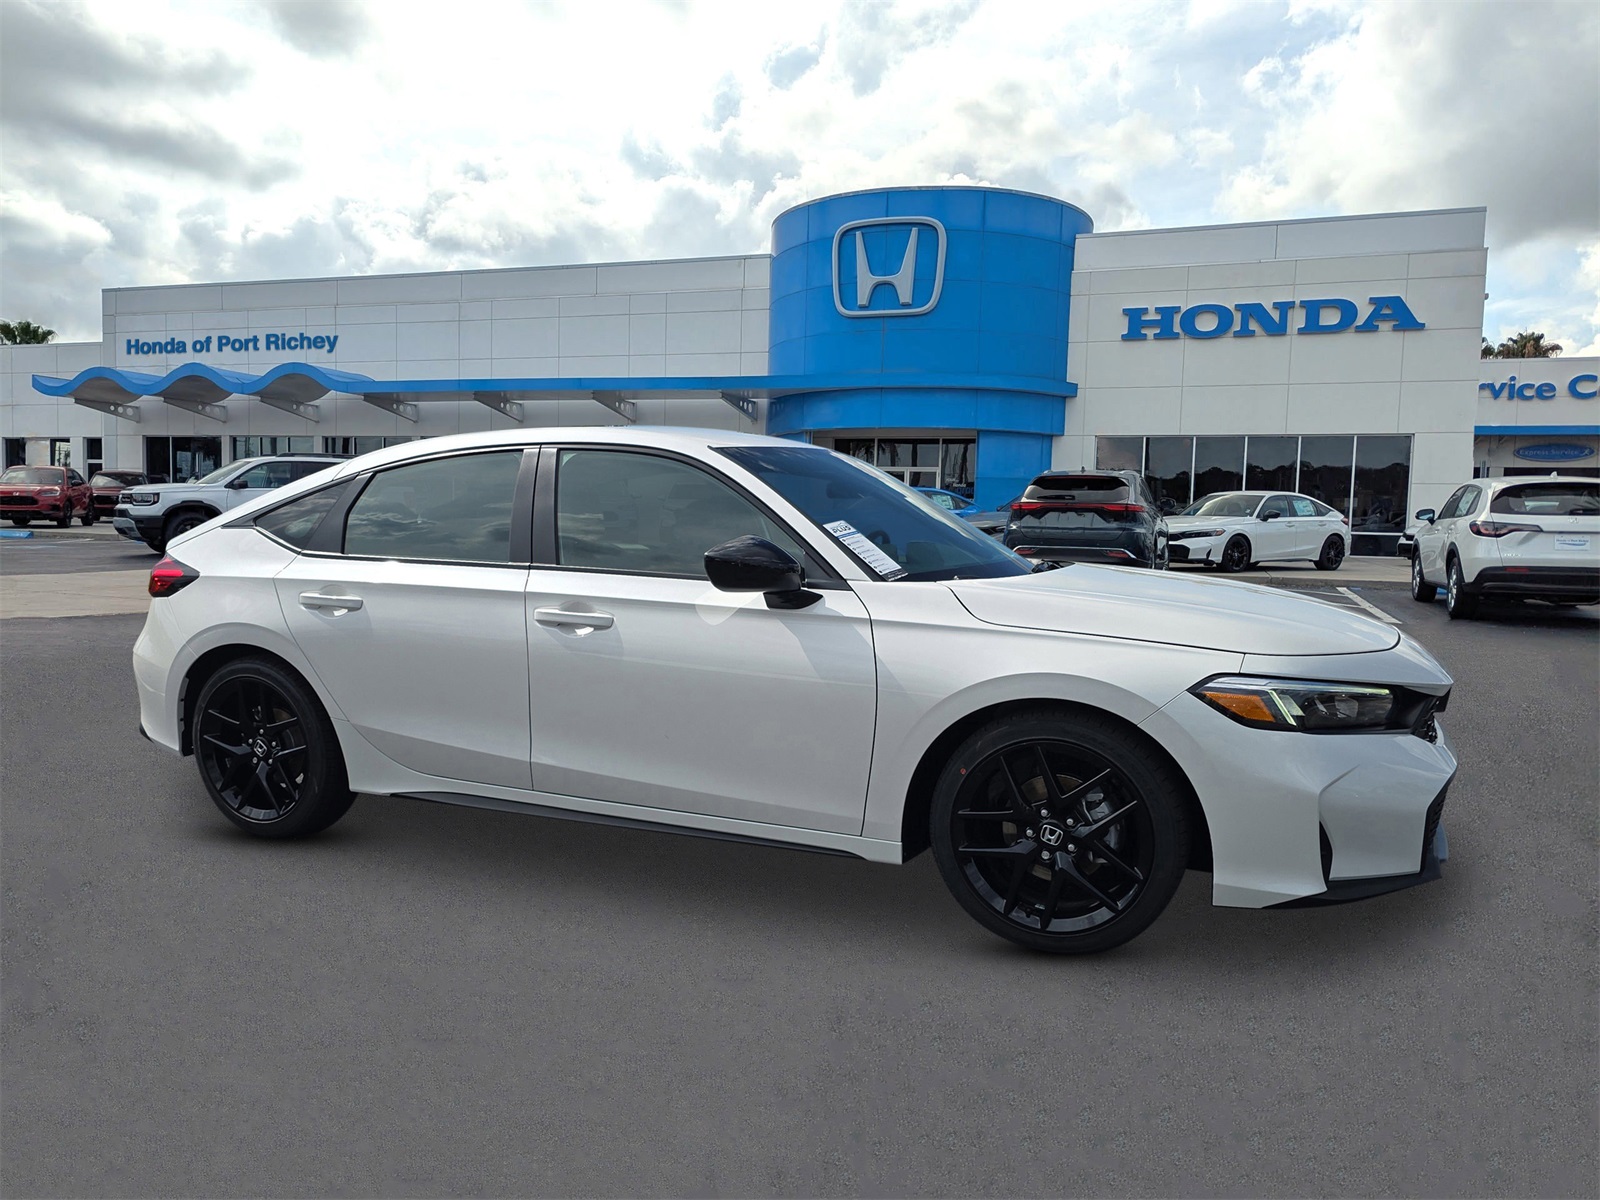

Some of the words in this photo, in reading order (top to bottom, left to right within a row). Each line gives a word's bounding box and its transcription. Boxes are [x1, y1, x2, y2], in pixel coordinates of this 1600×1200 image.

[1121, 295, 1426, 340] HONDA
[126, 337, 187, 355] Honda
[191, 336, 213, 353] of
[217, 335, 260, 352] Port
[265, 332, 339, 353] Richey
[1568, 374, 1600, 400] C
